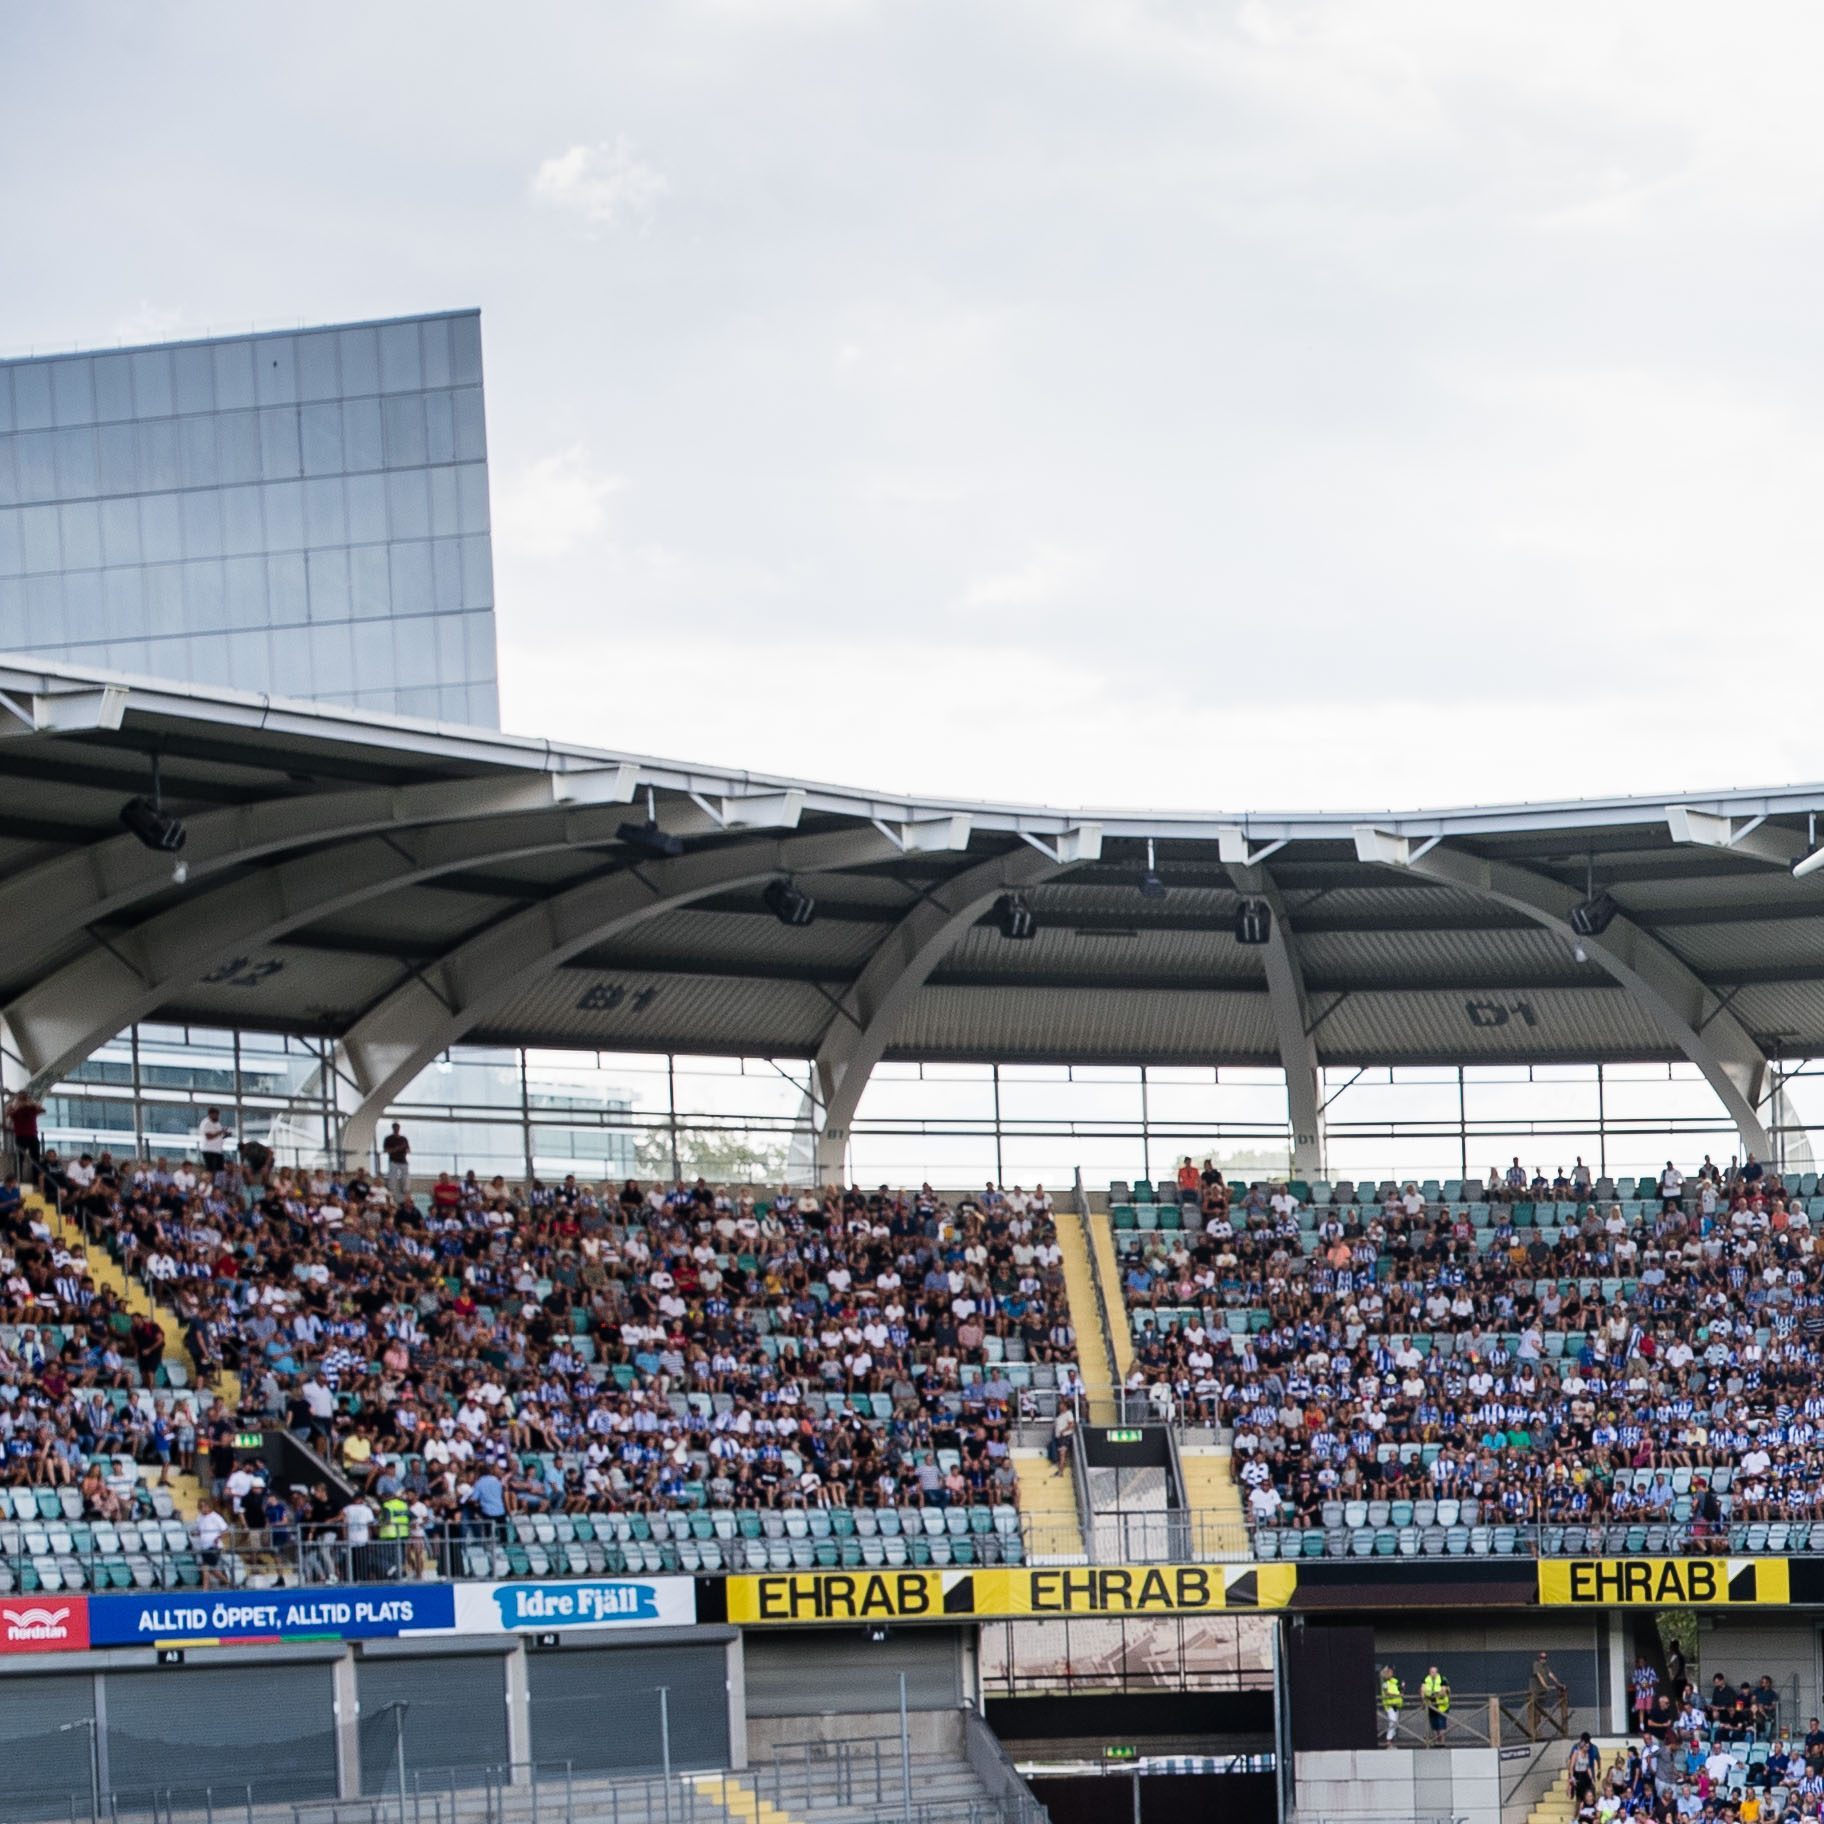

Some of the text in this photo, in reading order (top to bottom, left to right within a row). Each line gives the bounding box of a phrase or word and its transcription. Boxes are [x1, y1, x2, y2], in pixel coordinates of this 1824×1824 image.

[1466, 1001, 1537, 1028] D1
[758, 1573, 929, 1619] EHRAB
[1030, 1568, 1211, 1611] EHRAB
[1570, 1561, 1716, 1602] EHRAB
[139, 1601, 413, 1631] ALLTID ÖPPET, ALLTID PLATS
[516, 1587, 638, 1620] Idre Fjäll
[8, 1626, 66, 1640] Nordstan
